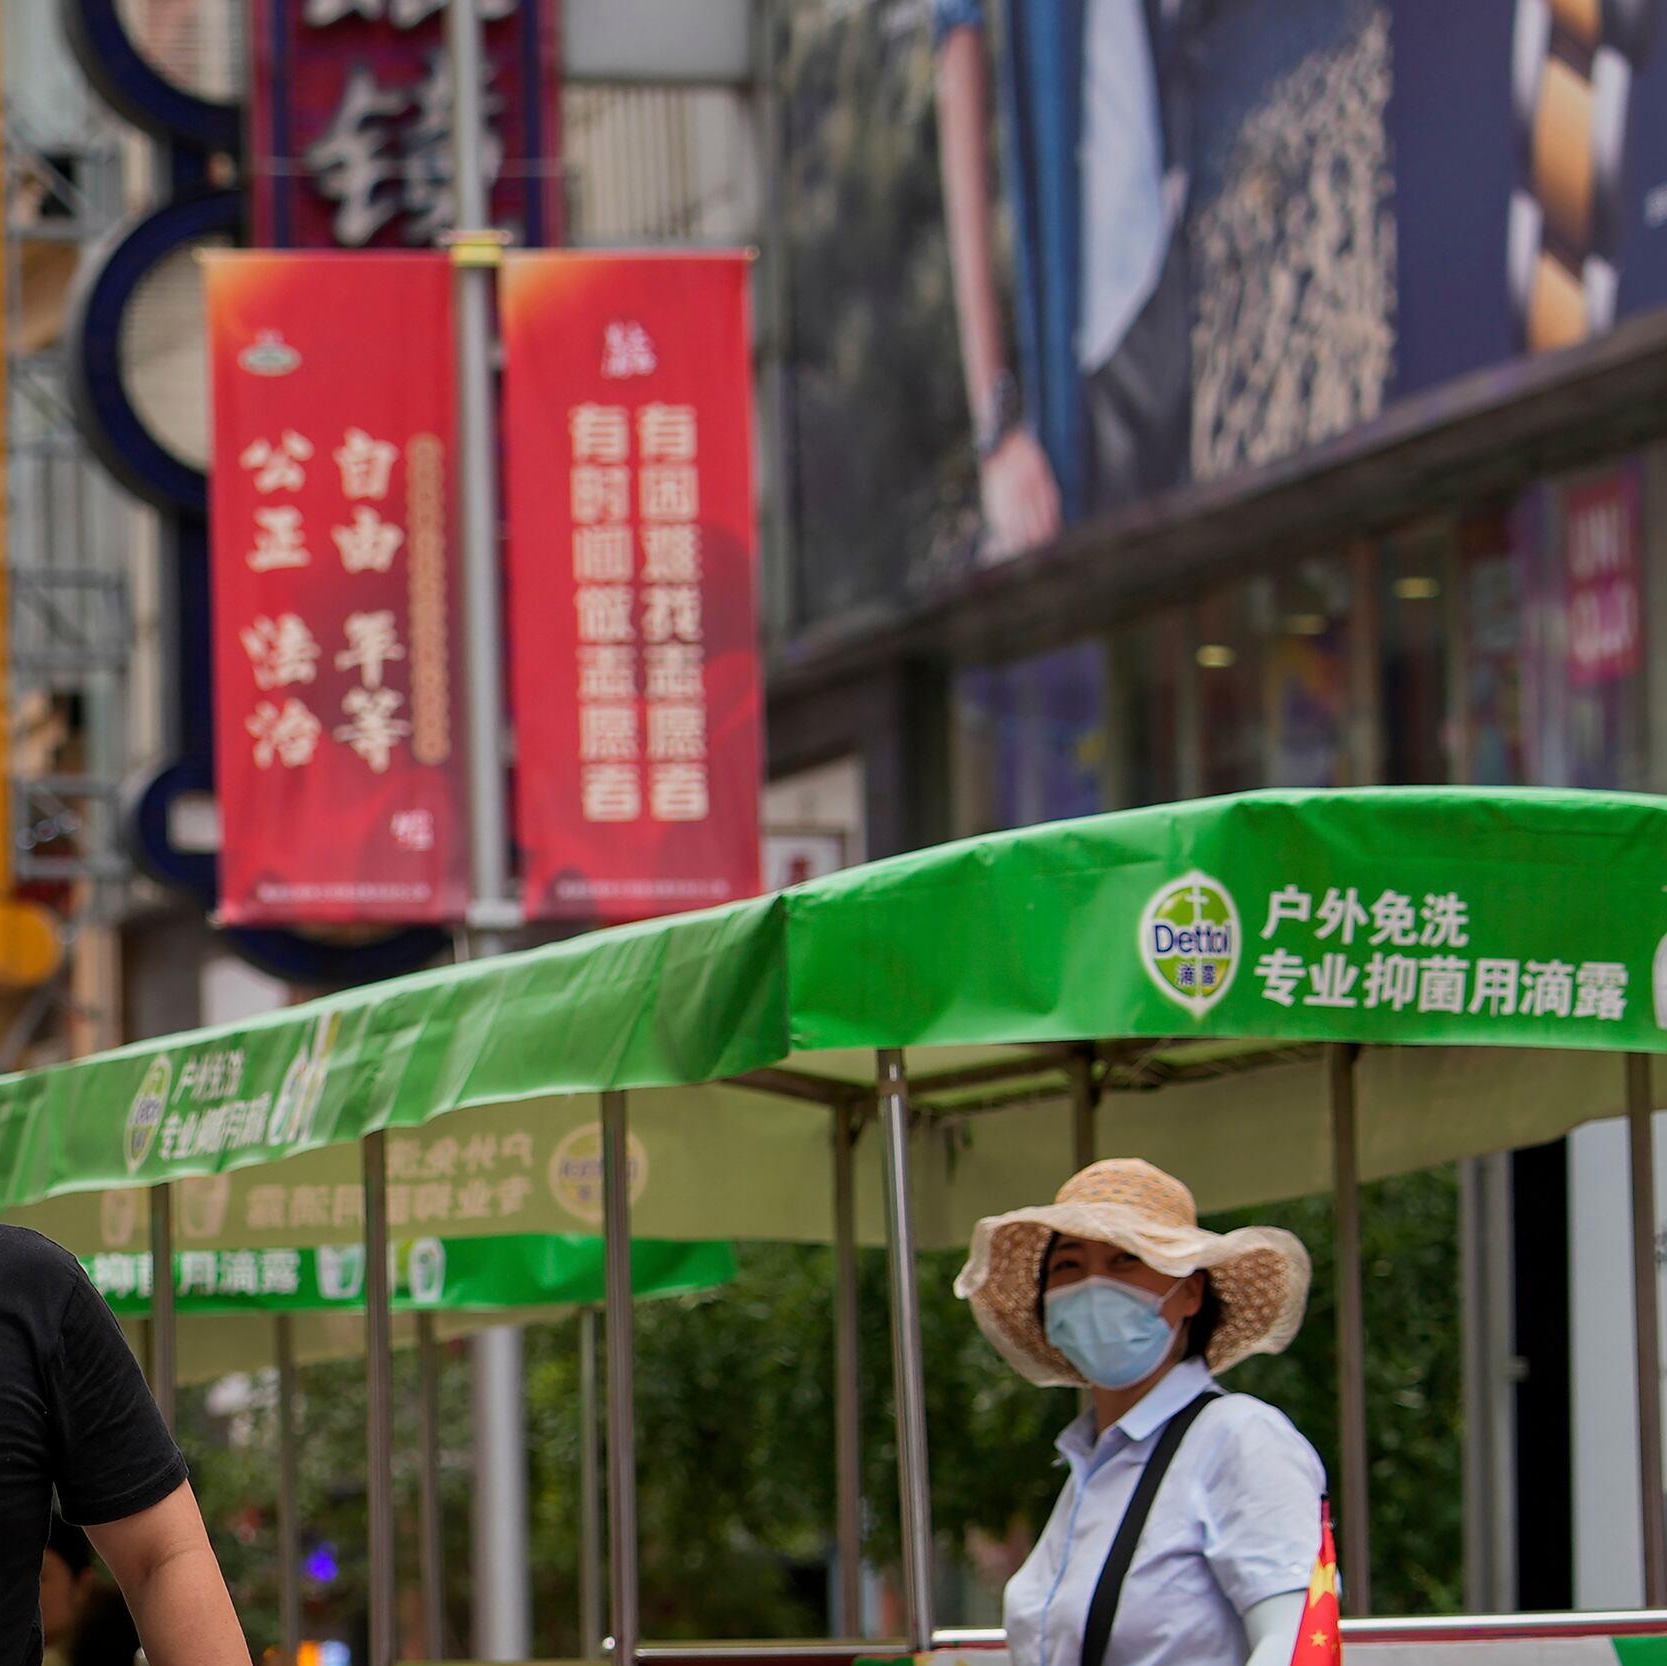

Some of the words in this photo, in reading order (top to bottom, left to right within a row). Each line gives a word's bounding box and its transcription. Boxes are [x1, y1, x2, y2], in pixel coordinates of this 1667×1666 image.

[1154, 922, 1232, 956] Dettol
[1260, 884, 1470, 949] 户外免洗
[1254, 948, 1630, 1022] 专业抑菌用滴露
